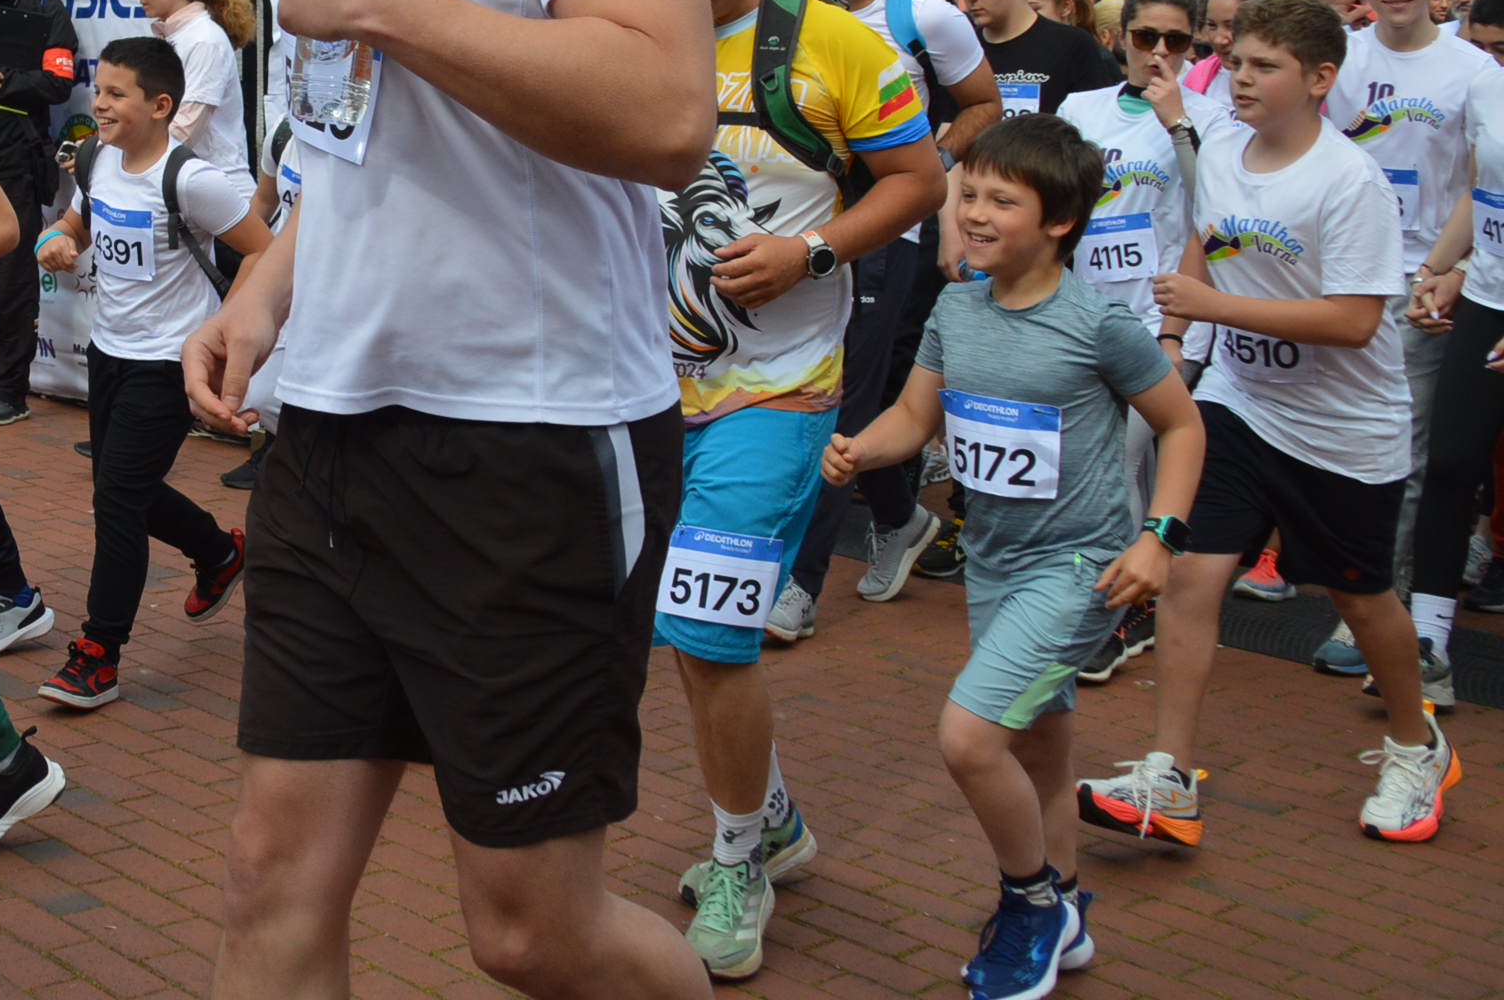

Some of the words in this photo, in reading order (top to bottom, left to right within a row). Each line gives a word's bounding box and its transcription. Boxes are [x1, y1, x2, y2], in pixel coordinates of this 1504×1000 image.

[1372, 97, 1446, 121] Marathon
[1402, 109, 1441, 130] Varna
[1104, 160, 1171, 184] Marathon
[283, 190, 299, 208] 4
[95, 230, 144, 267] 4391
[1220, 214, 1305, 257] Marathon
[1089, 242, 1143, 271] 4115
[1251, 235, 1297, 266] Varna
[1224, 328, 1300, 370] 4510
[973, 402, 1019, 417] DECATHLON
[953, 435, 1037, 487] 5172
[704, 533, 754, 548] DECATHLON
[669, 567, 762, 616] 5173
[496, 781, 552, 805] JAKO
